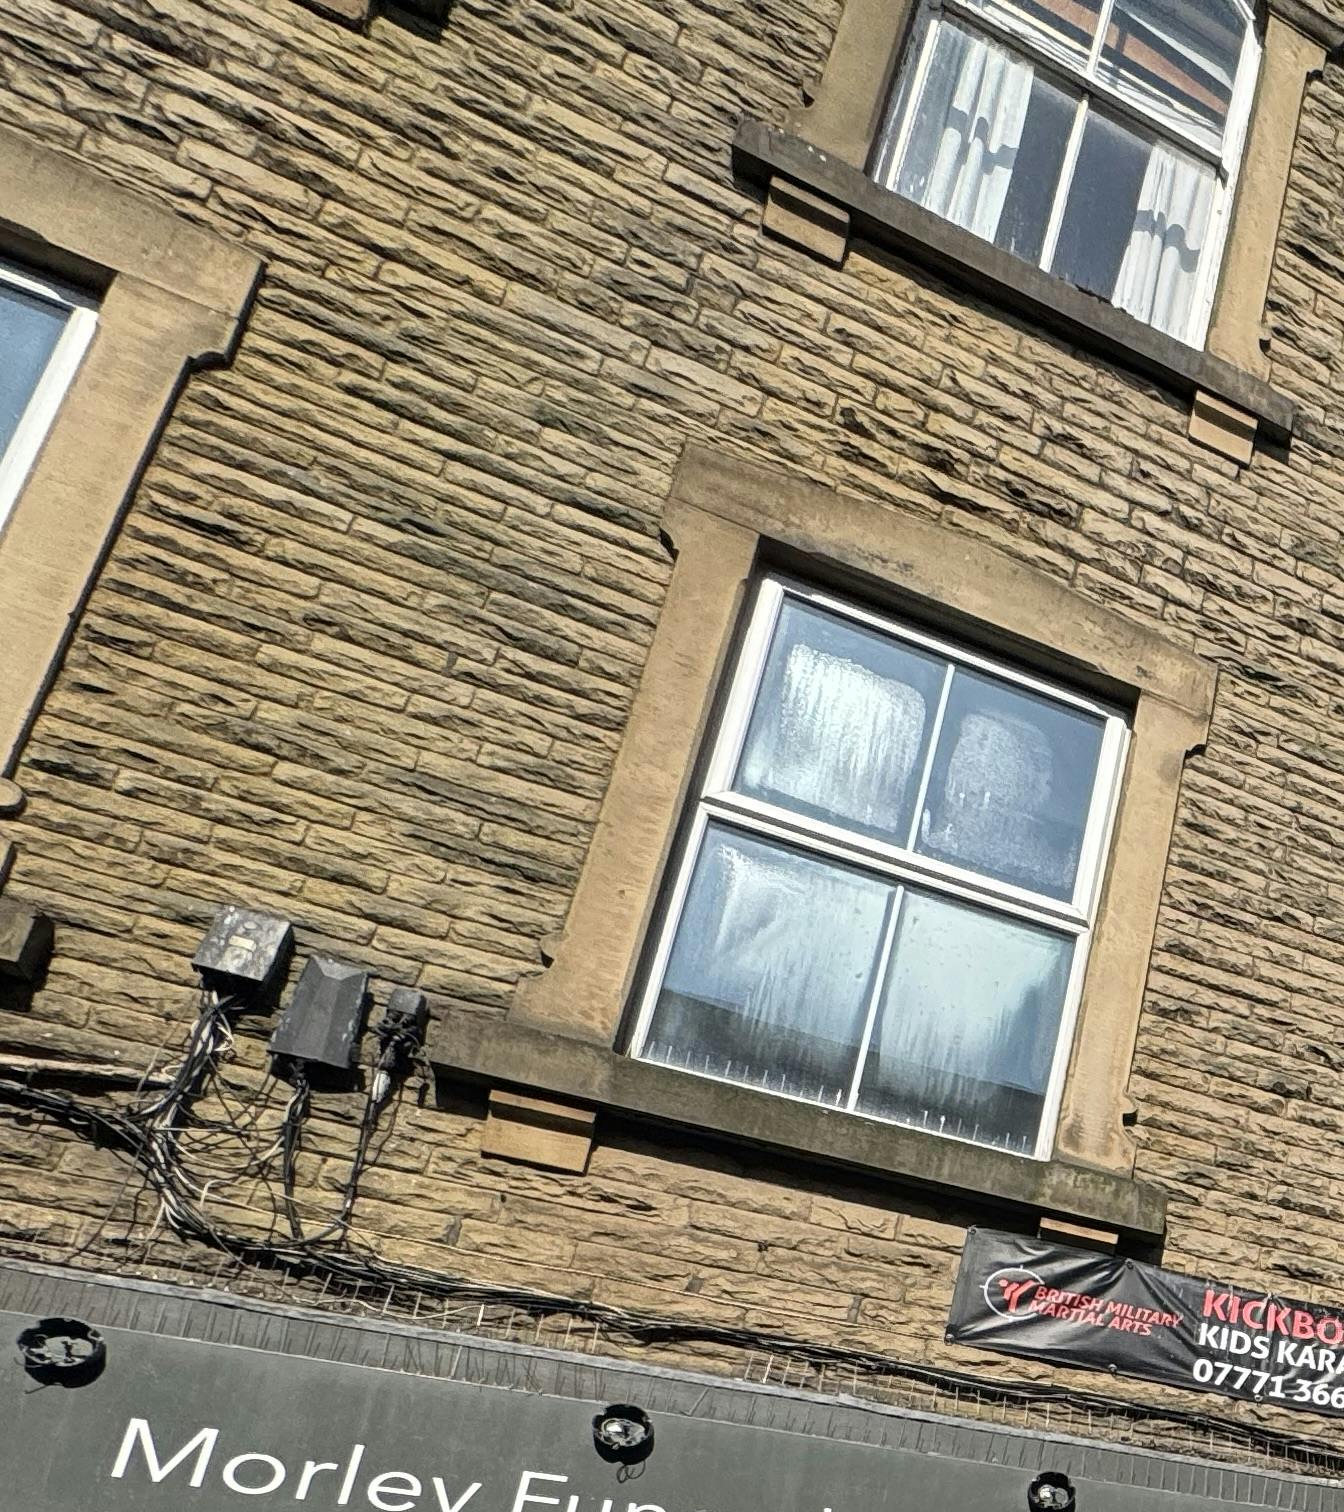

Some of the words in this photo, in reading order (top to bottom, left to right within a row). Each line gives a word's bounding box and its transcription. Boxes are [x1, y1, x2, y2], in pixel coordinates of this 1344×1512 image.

[1028, 1301, 1105, 1327] MARTIAL
[1110, 1317, 1154, 1337] ARTS
[1034, 1286, 1103, 1312] BRITISH
[1104, 1299, 1185, 1329] MILITARY
[1198, 1323, 1271, 1360] KIDS
[1192, 1358, 1286, 1399] 07771
